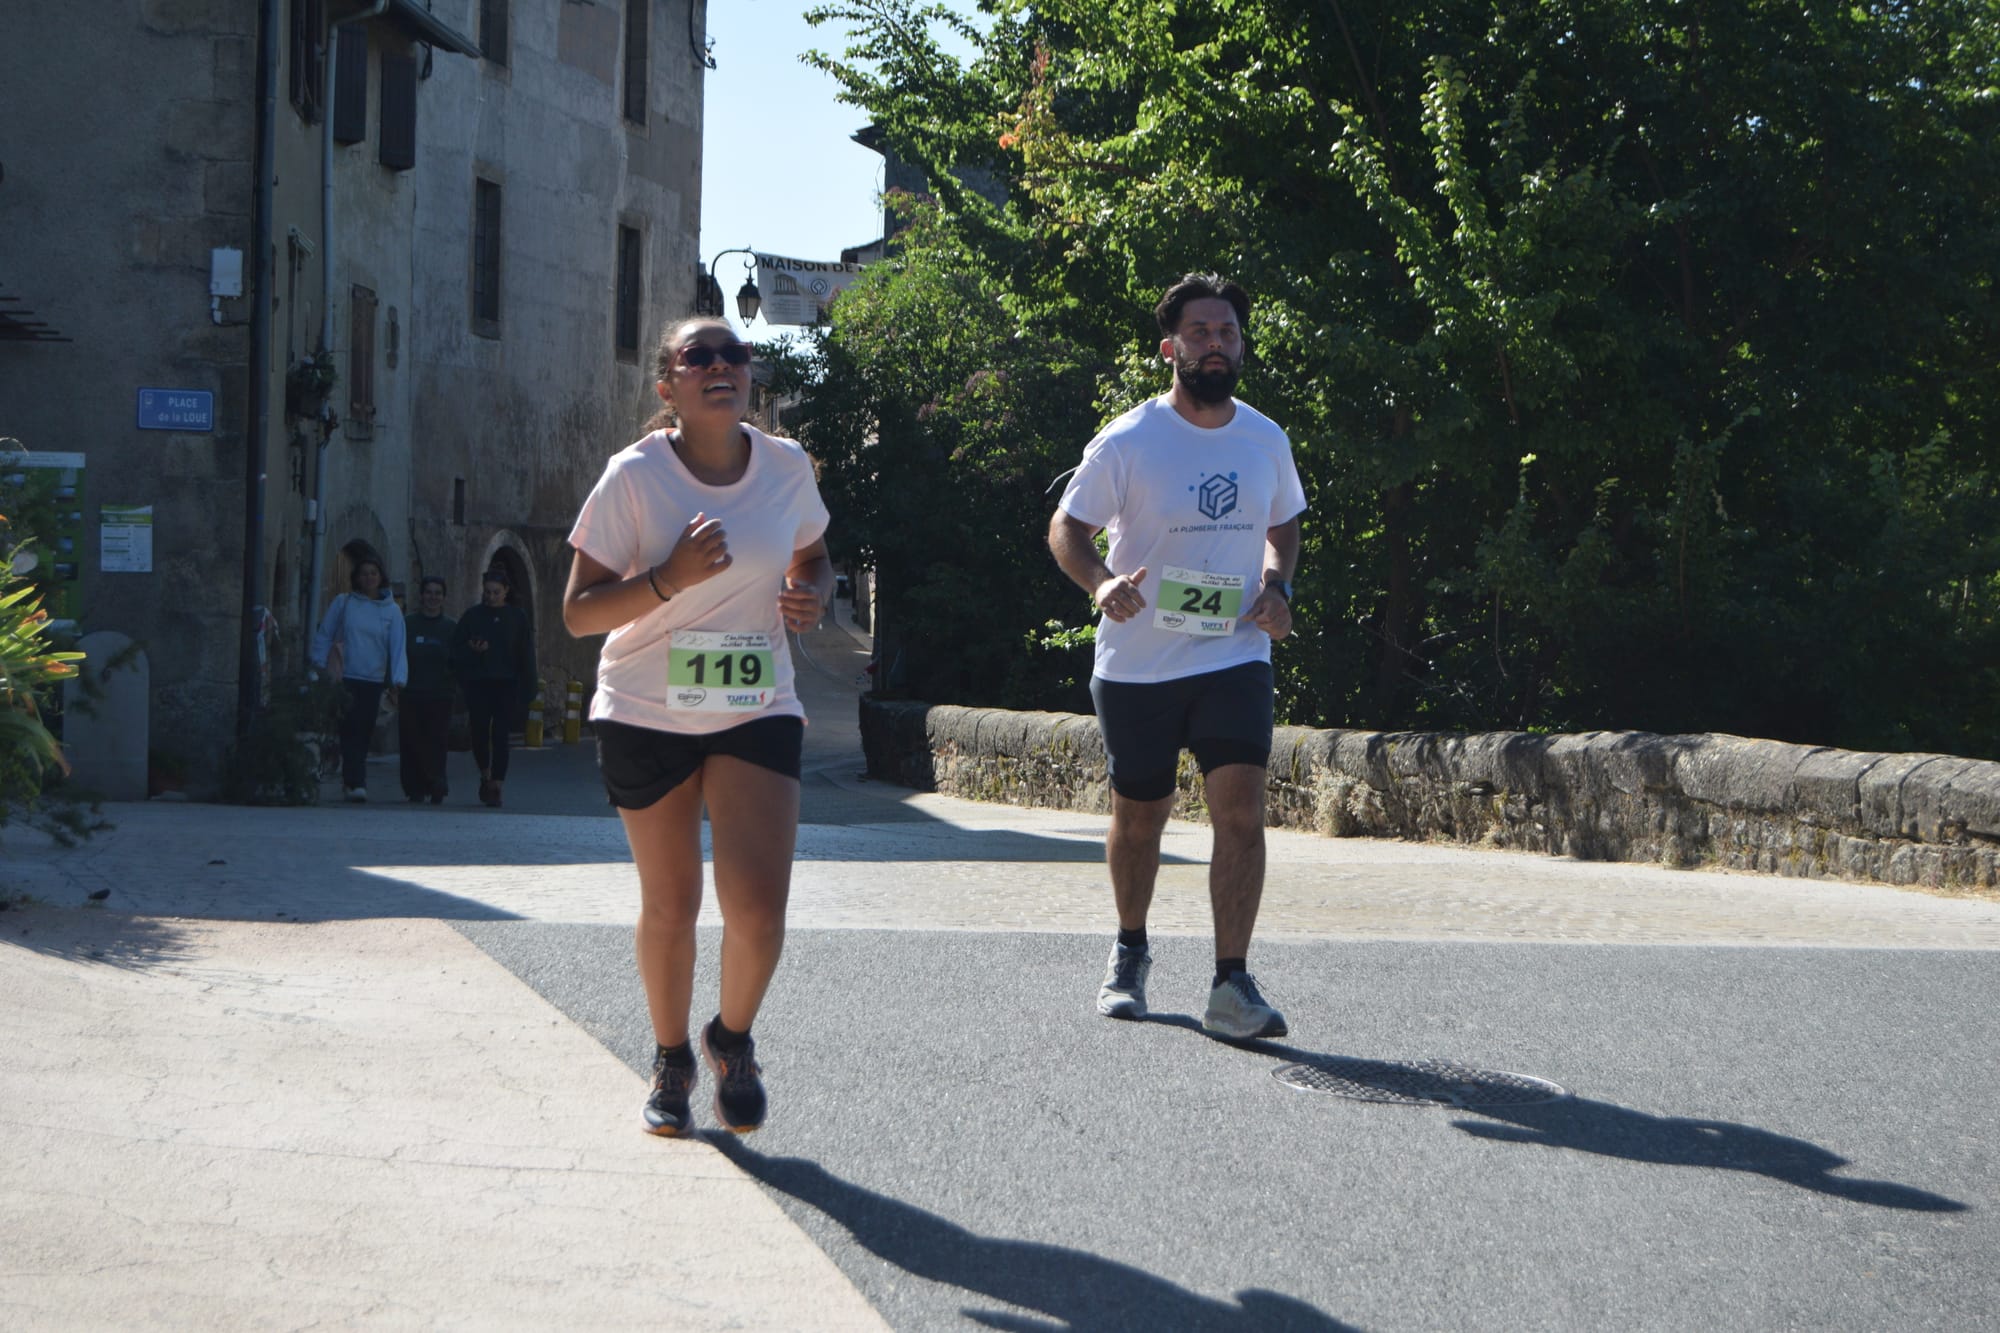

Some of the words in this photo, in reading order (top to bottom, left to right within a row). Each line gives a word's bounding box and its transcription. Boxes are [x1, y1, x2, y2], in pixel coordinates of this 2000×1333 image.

[761, 257, 828, 272] MAISON
[833, 263, 854, 273] DE
[168, 397, 198, 409] PLACE
[183, 412, 208, 423] LOUE
[1180, 524, 1218, 533] PLOMBERIE
[1180, 587, 1222, 615] 24
[686, 653, 762, 685] 119
